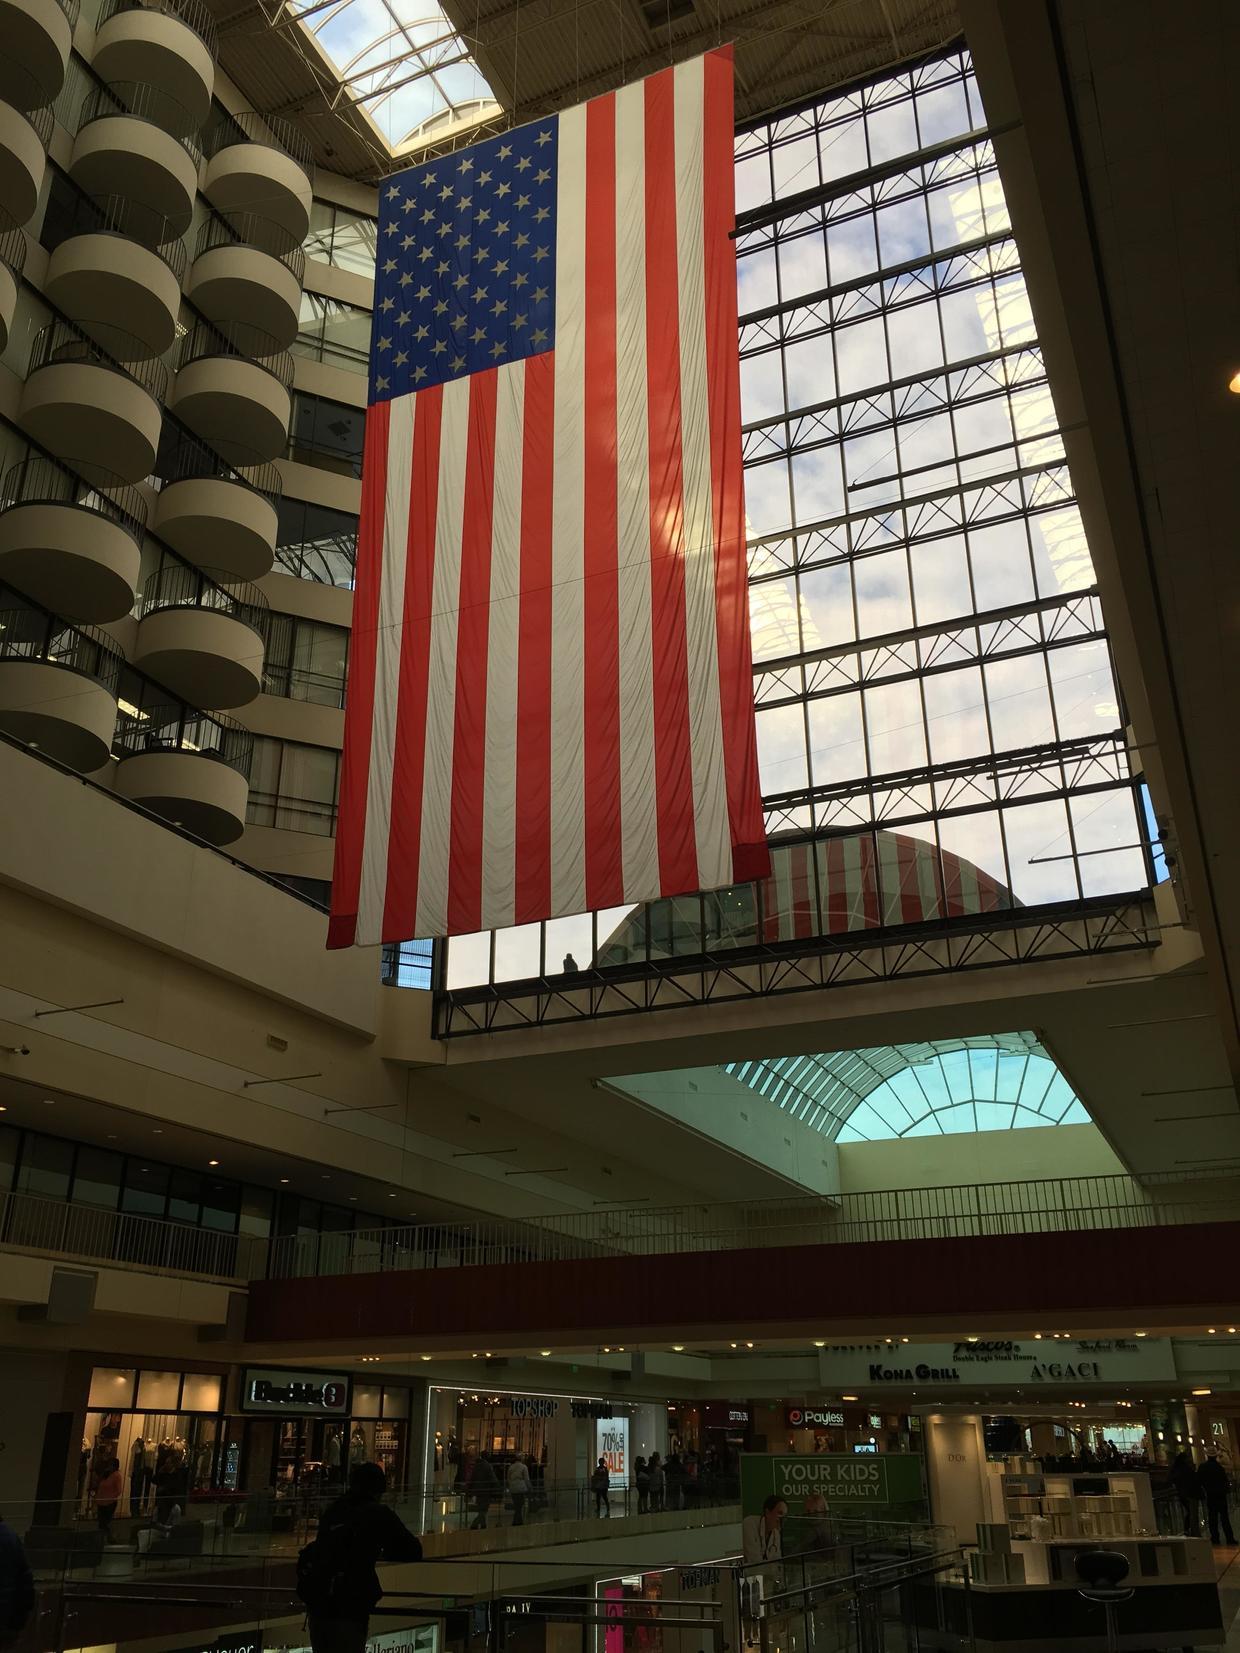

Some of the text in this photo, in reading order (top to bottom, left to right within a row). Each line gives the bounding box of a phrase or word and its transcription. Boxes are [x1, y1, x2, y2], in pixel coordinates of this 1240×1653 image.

[511, 1399, 559, 1418] TOPSHOP
[805, 1410, 844, 1426] Payless
[602, 1433, 620, 1451] 70%
[602, 1452, 625, 1473] SALE
[780, 1464, 879, 1480] YOUR KIDS
[782, 1483, 880, 1496] OUR SPECIALTY
